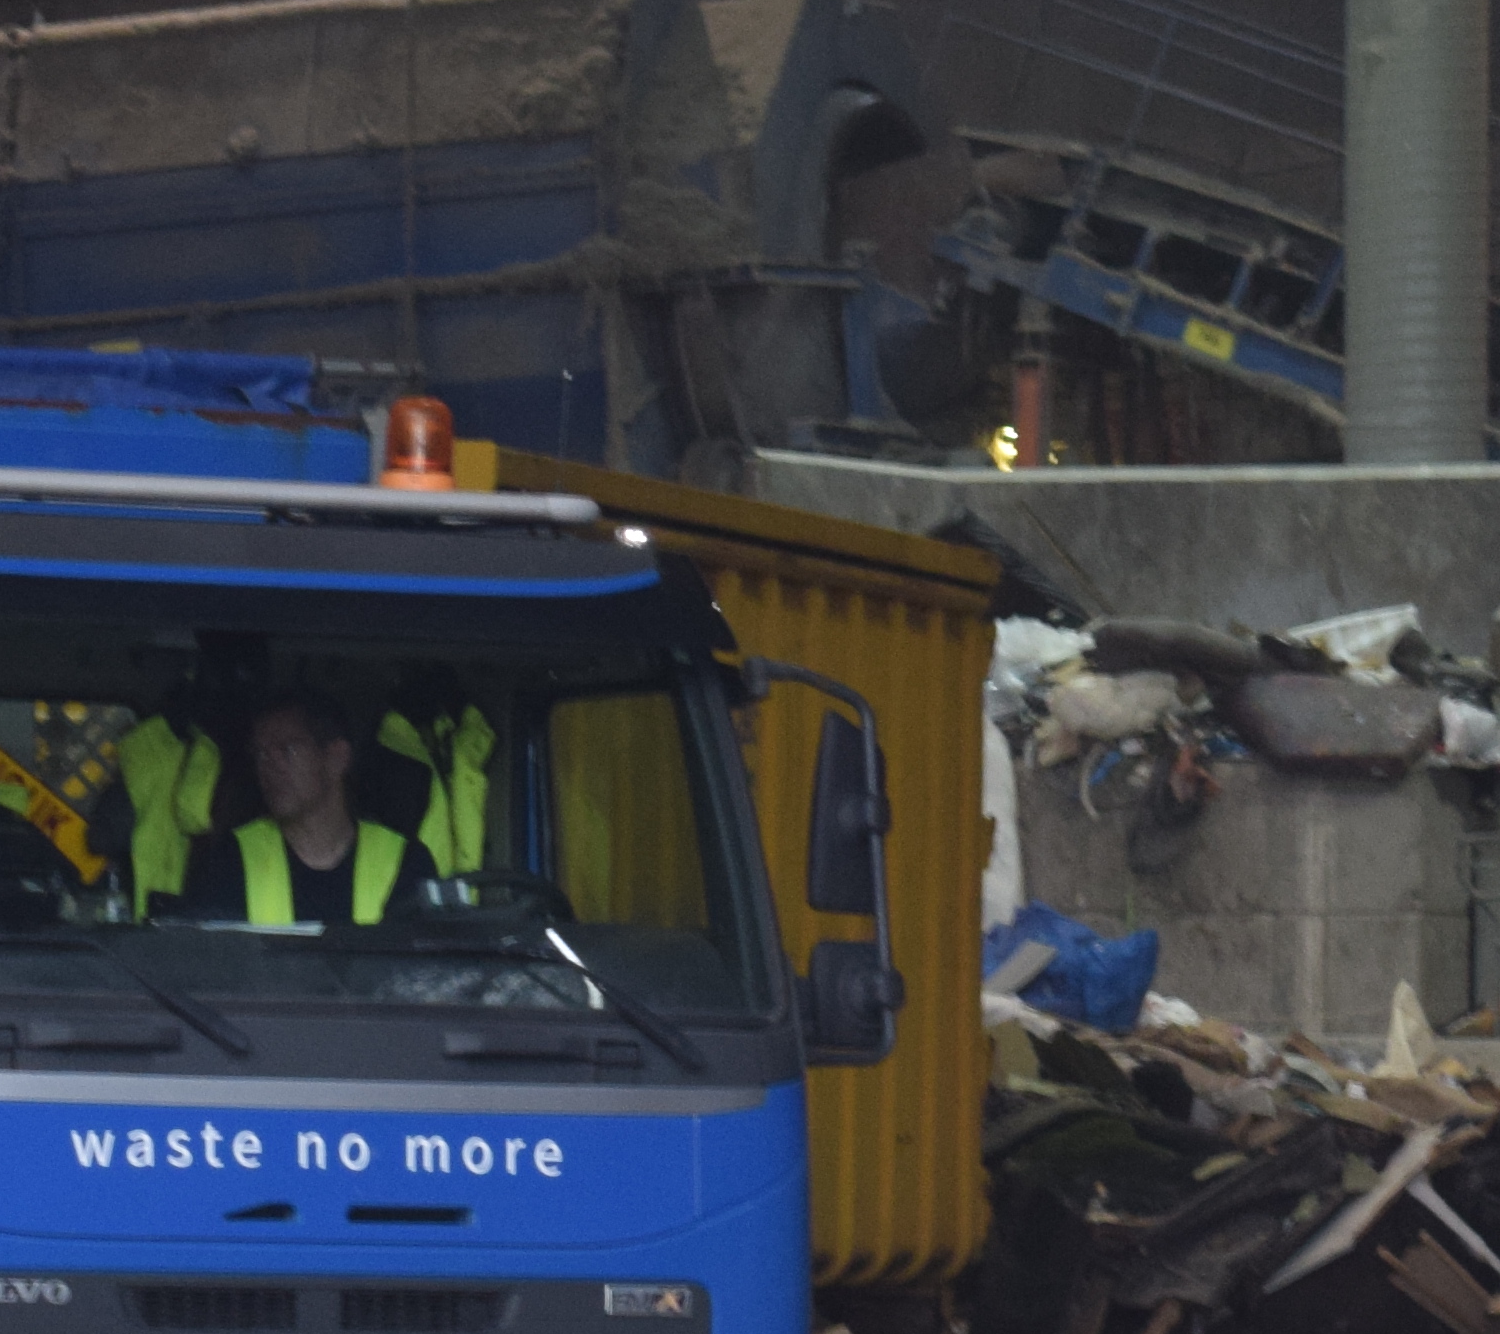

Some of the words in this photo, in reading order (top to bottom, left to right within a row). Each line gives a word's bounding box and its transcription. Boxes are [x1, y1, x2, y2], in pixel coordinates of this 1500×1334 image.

[71, 1121, 263, 1169] waste
[297, 1130, 372, 1171] no
[405, 1133, 565, 1179] more
